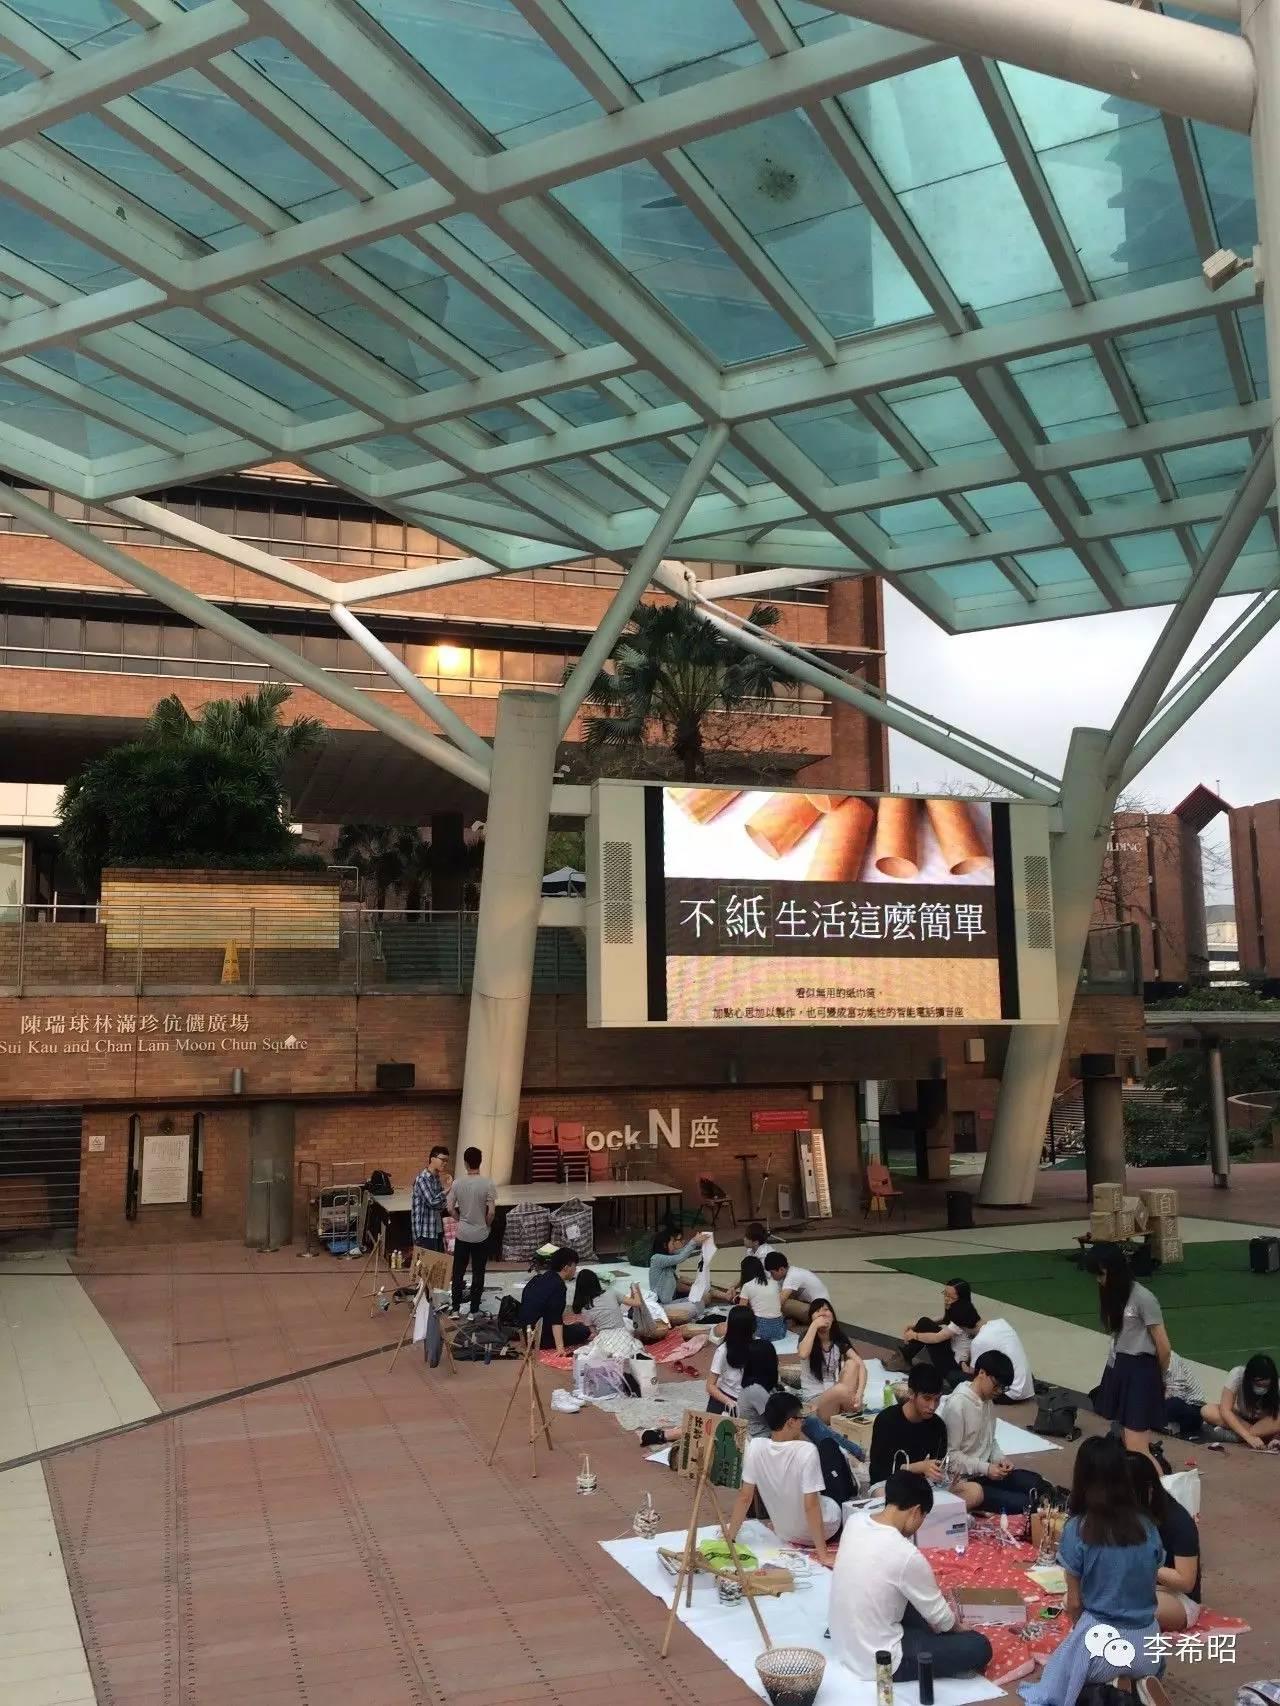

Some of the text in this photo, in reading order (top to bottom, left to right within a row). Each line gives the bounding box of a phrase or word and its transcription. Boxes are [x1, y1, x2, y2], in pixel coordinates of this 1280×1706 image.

[679, 894, 988, 942] 不紙生活這麼簡單
[20, 1013, 250, 1035] 陳瑞球林滿珍伉儷廣場
[0, 1040, 22, 1054] Sui
[28, 1040, 59, 1054] Kau
[63, 1039, 90, 1054] and
[95, 1039, 133, 1053] Chan
[138, 1039, 170, 1052] Lam
[176, 1038, 216, 1052] Moon
[221, 1037, 258, 1051] Chun
[585, 1124, 642, 1152] ock
[648, 1108, 681, 1149] N
[689, 1115, 720, 1149] 座
